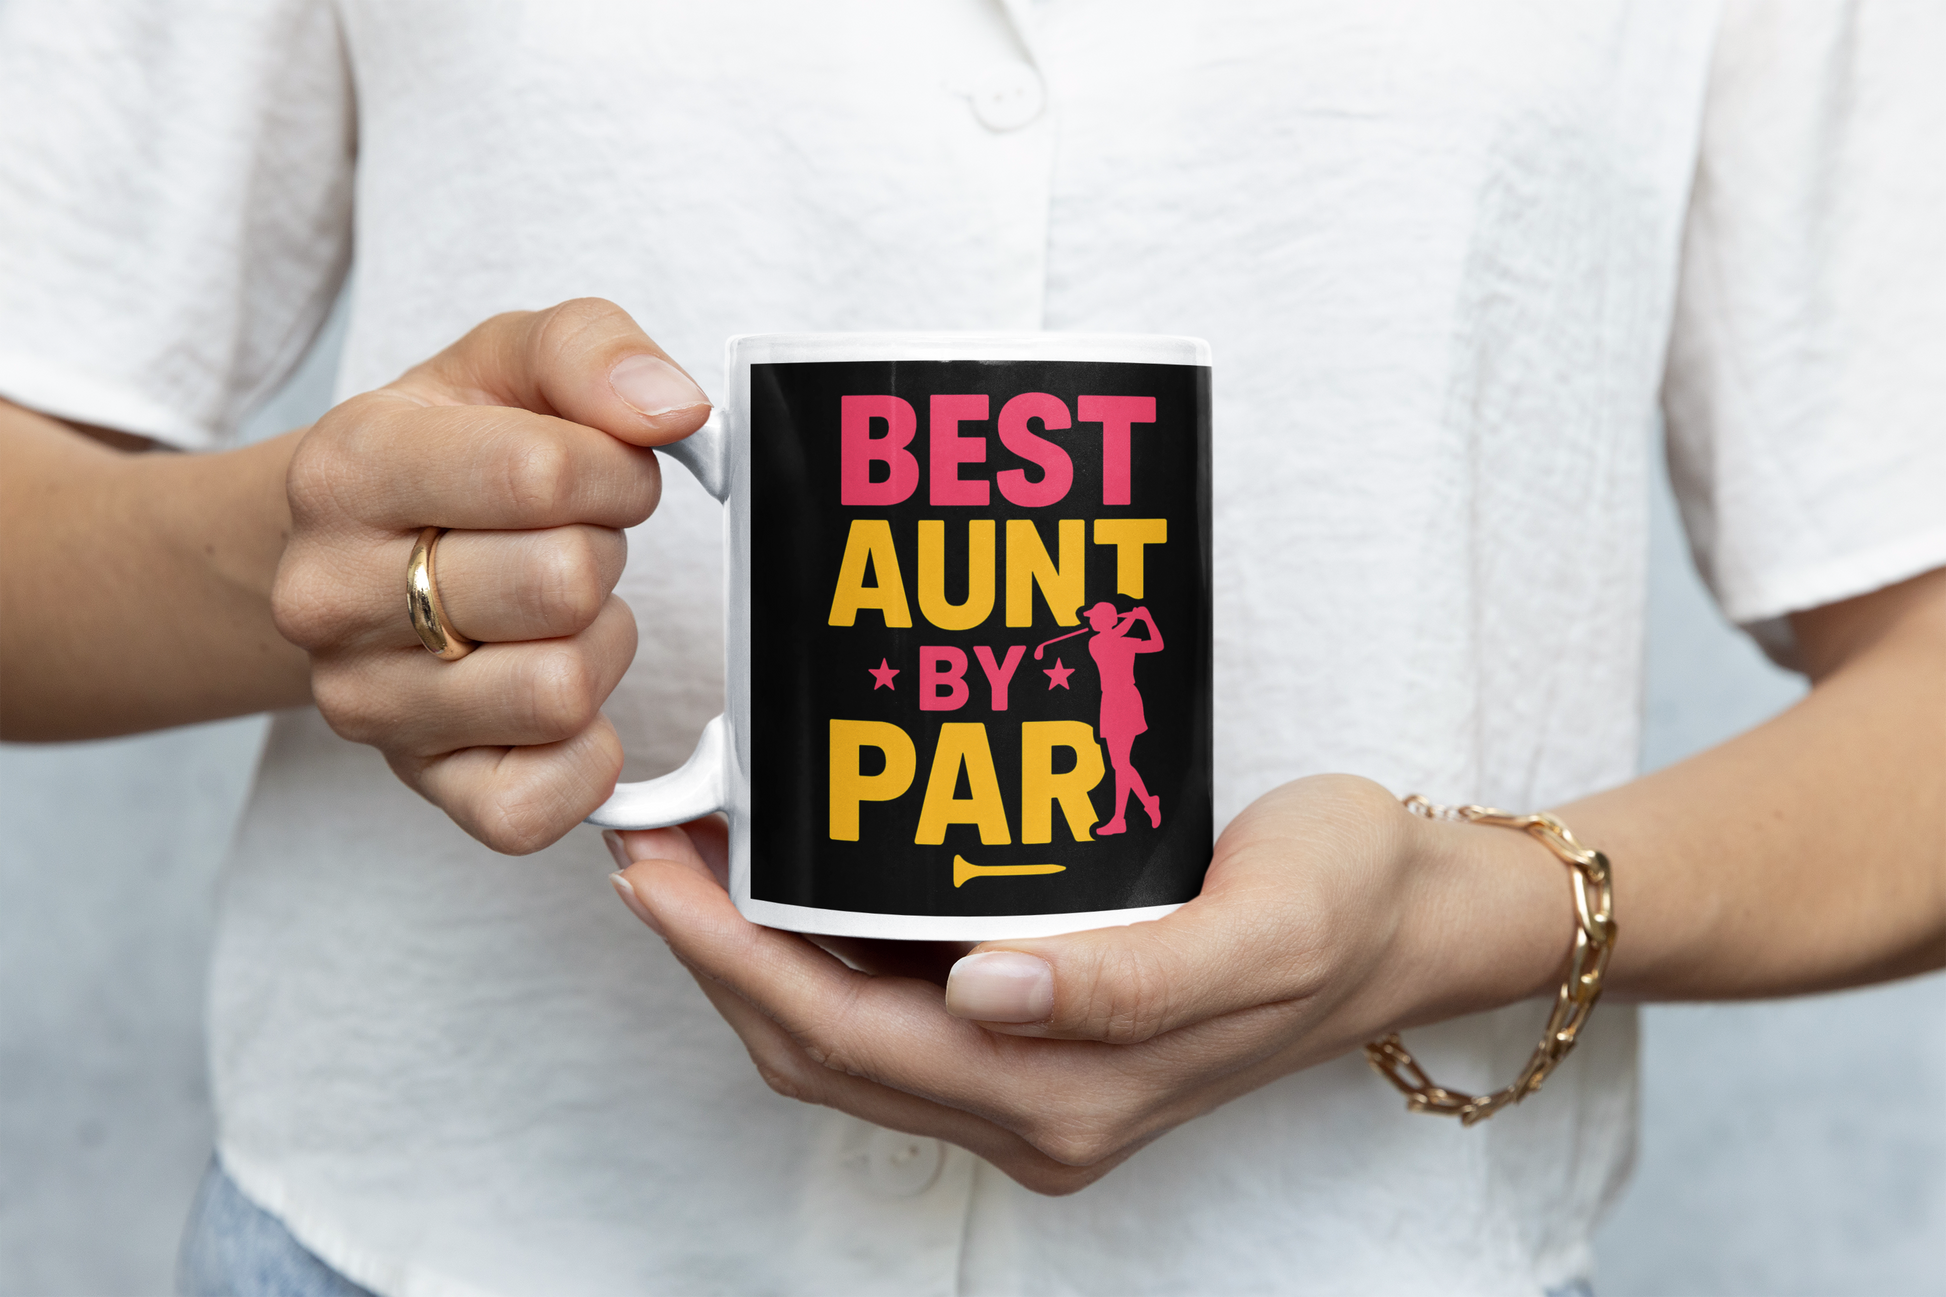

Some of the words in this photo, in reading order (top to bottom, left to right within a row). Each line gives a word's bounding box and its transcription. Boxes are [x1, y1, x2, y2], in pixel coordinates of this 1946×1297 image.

[840, 391, 1157, 507] BEST
[827, 518, 1168, 631] AUNT
[919, 645, 1027, 712] BY
[829, 718, 1106, 846] PAR
